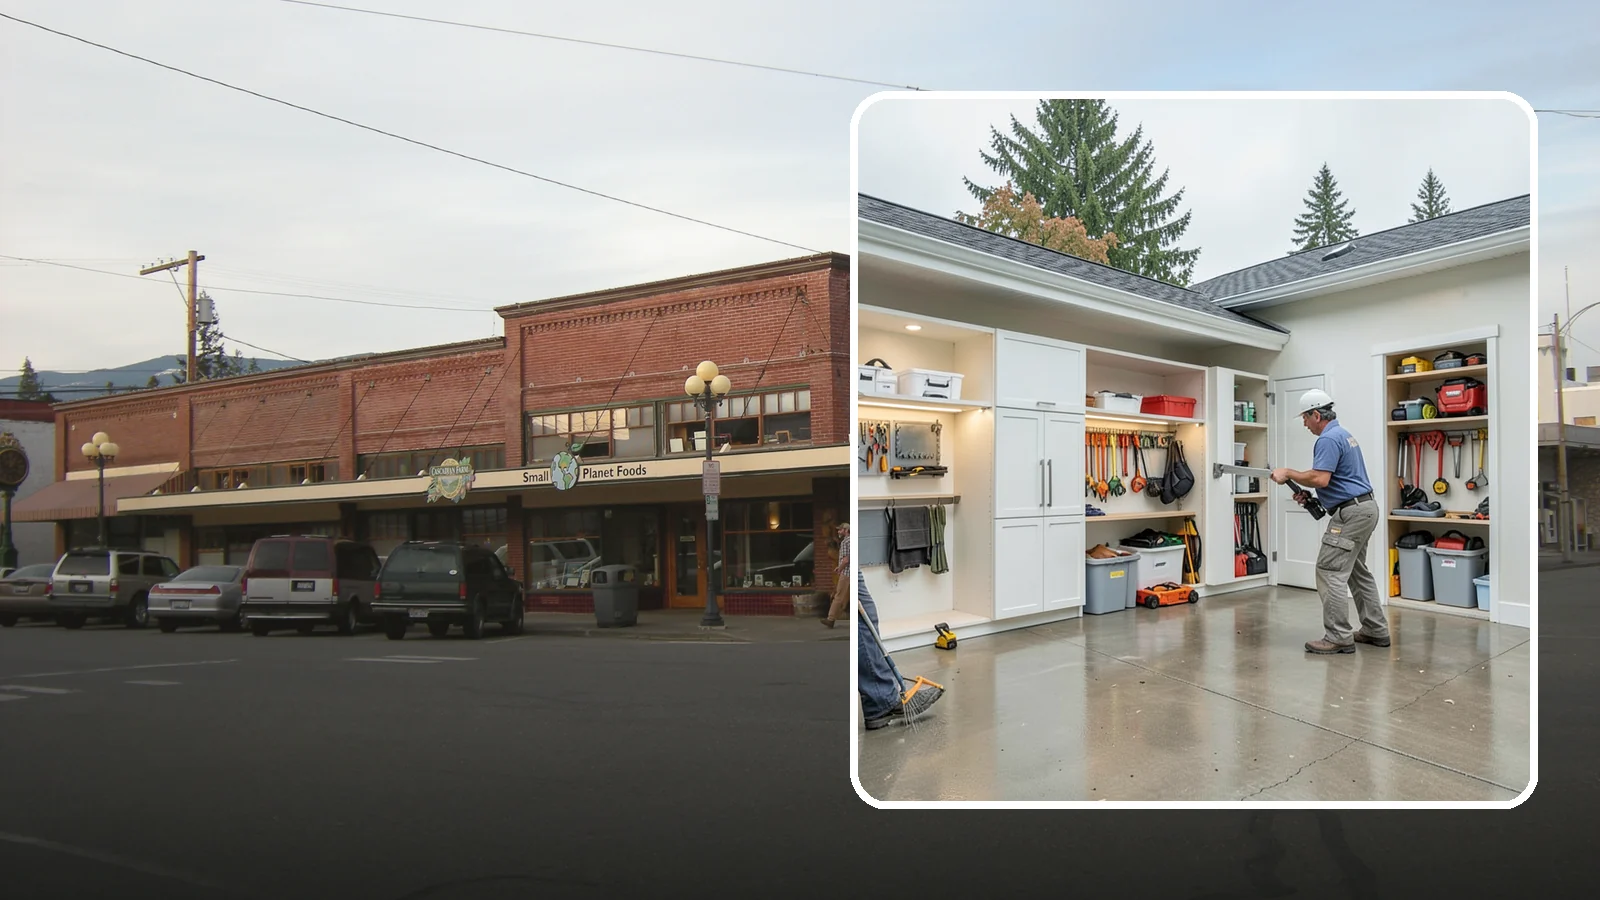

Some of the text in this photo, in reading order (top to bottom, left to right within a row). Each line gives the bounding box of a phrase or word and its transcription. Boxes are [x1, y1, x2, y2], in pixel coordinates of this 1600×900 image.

[523, 464, 647, 483] Small Planet Foods
